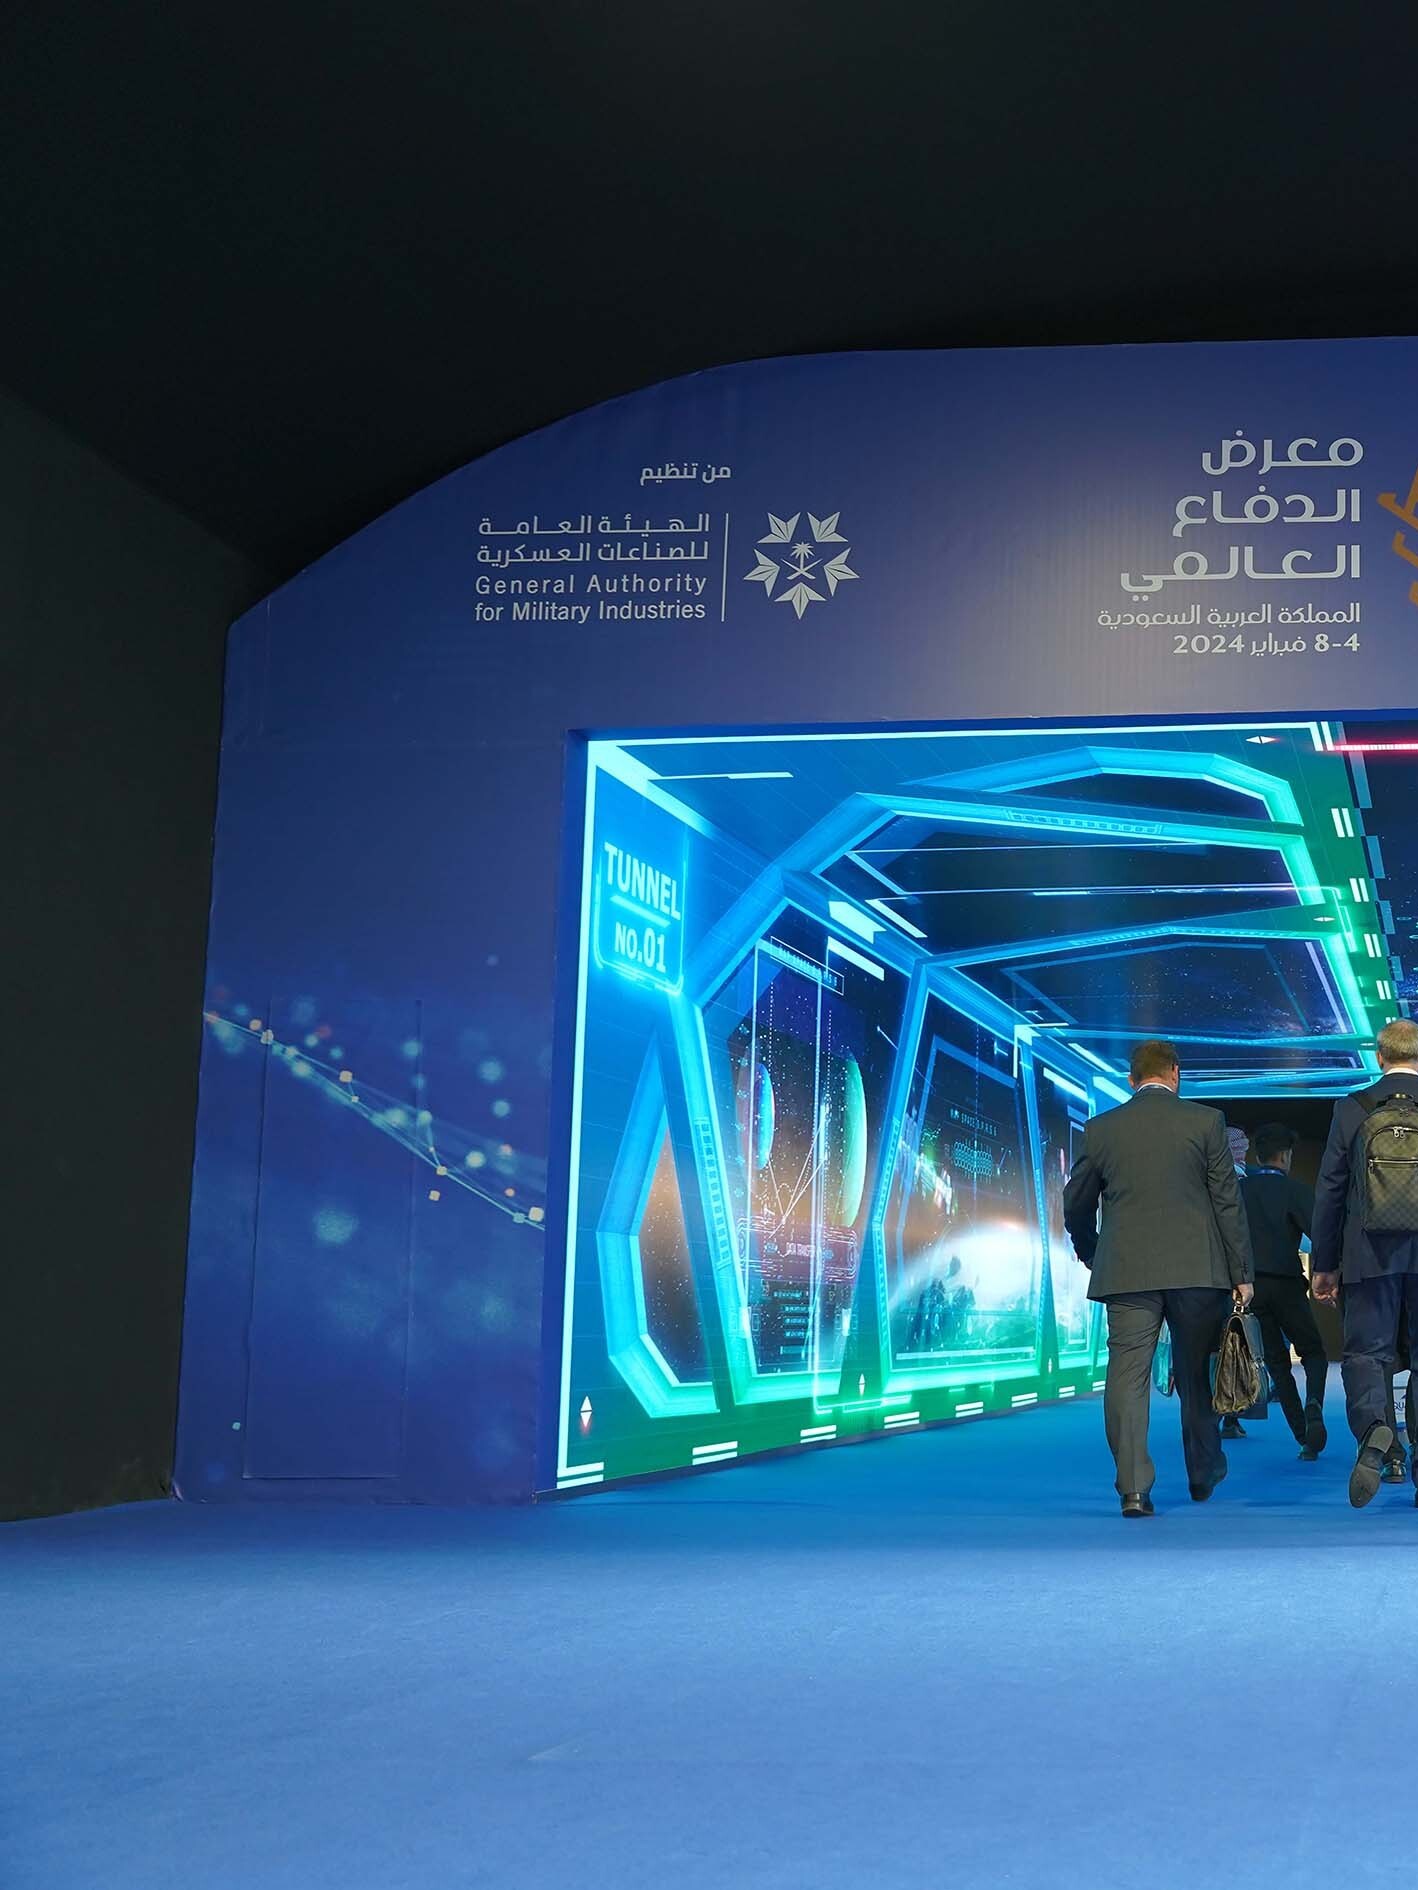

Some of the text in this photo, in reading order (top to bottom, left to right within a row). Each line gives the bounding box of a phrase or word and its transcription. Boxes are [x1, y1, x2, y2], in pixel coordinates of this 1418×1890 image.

[1201, 429, 1364, 476] معرض
[639, 462, 731, 486] من تنظيم
[1172, 485, 1361, 538] الدفاع
[478, 513, 710, 538] الهيئة العامة
[476, 540, 709, 569] للصناعات العسكرية
[475, 573, 707, 596] General Authority
[1120, 544, 1361, 602] العالمي
[474, 599, 706, 624] for Military Industries
[1097, 602, 1361, 630] المملكة العربية السعودية
[1173, 634, 1245, 654] 2024
[1249, 632, 1307, 657] فبراير
[604, 841, 681, 920] TUNNEL
